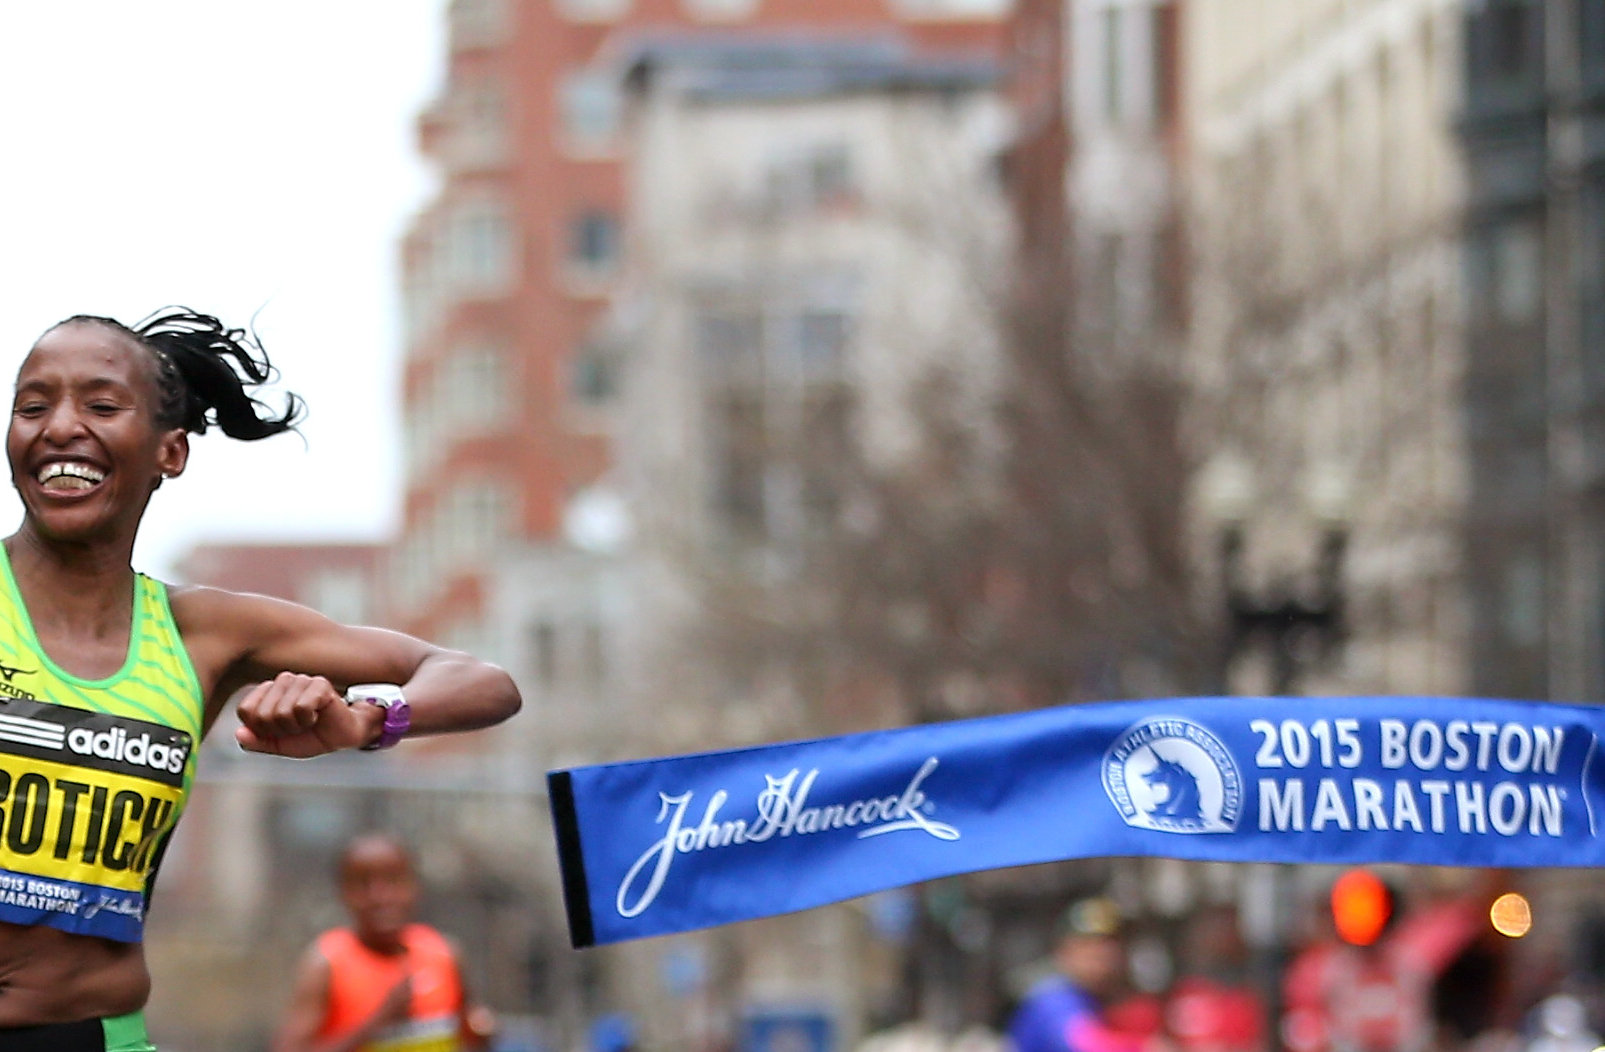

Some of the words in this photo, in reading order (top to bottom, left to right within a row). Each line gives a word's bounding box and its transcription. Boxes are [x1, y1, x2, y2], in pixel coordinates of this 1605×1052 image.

[67, 726, 186, 774] adidas
[1250, 718, 1362, 769] 2015
[1379, 719, 1564, 776] BOSTON
[745, 757, 961, 843] Hancock
[1257, 777, 1563, 837] MARATHON
[27, 879, 82, 900] BOSTON
